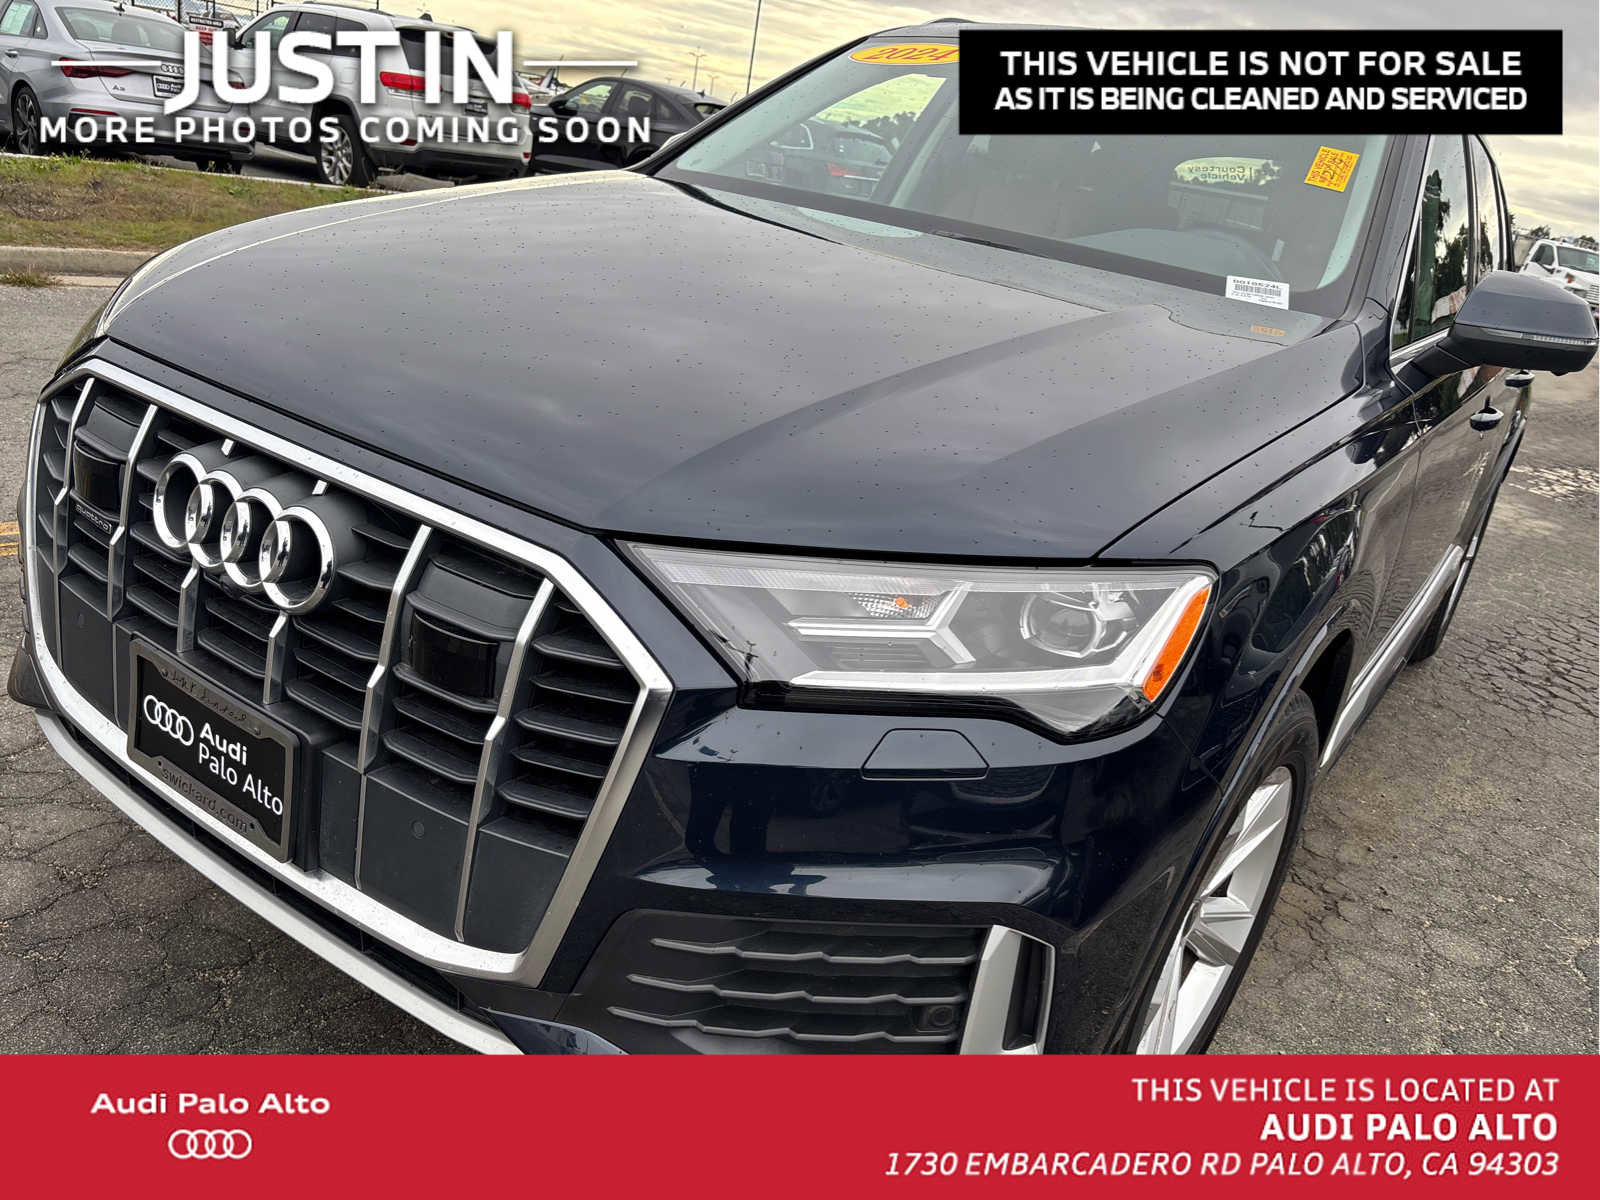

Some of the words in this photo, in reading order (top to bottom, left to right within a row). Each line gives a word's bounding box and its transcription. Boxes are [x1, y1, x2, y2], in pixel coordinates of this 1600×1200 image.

[864, 47, 960, 61] 2024
[75, 504, 109, 531] quattro
[200, 722, 248, 766] Audi
[162, 767, 248, 834] swickard.com
[199, 743, 238, 786] Palo
[243, 773, 283, 815] Alto
